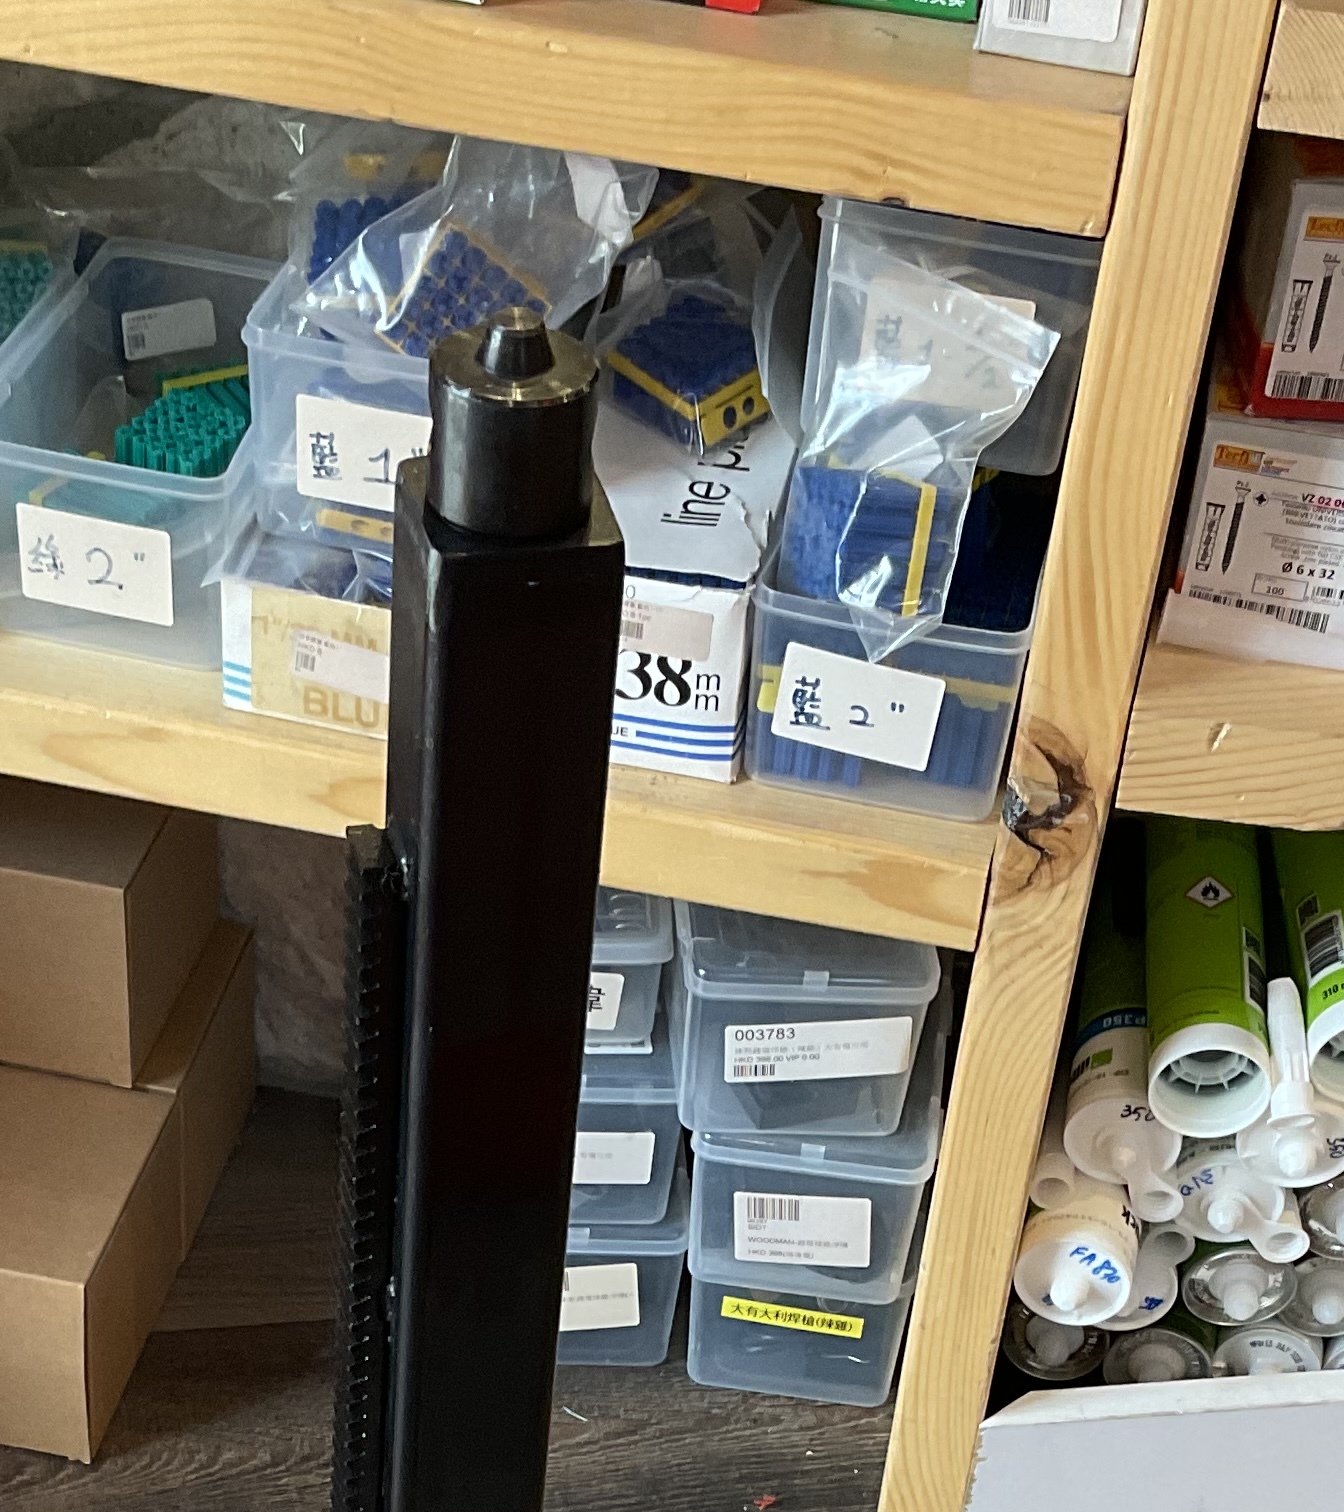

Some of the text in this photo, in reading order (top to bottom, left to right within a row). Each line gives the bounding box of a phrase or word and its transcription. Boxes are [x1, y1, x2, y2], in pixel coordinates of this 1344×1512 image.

[660, 480, 731, 526] line
[1301, 492, 1315, 504] VZ
[1317, 495, 1331, 507] 02
[1296, 564, 1305, 575] 6
[1307, 567, 1316, 577] x
[1318, 567, 1336, 581] 32
[1265, 586, 1285, 596] 100
[302, 686, 381, 728] BLU
[1321, 983, 1340, 1001] 310
[733, 1027, 796, 1042] 003783
